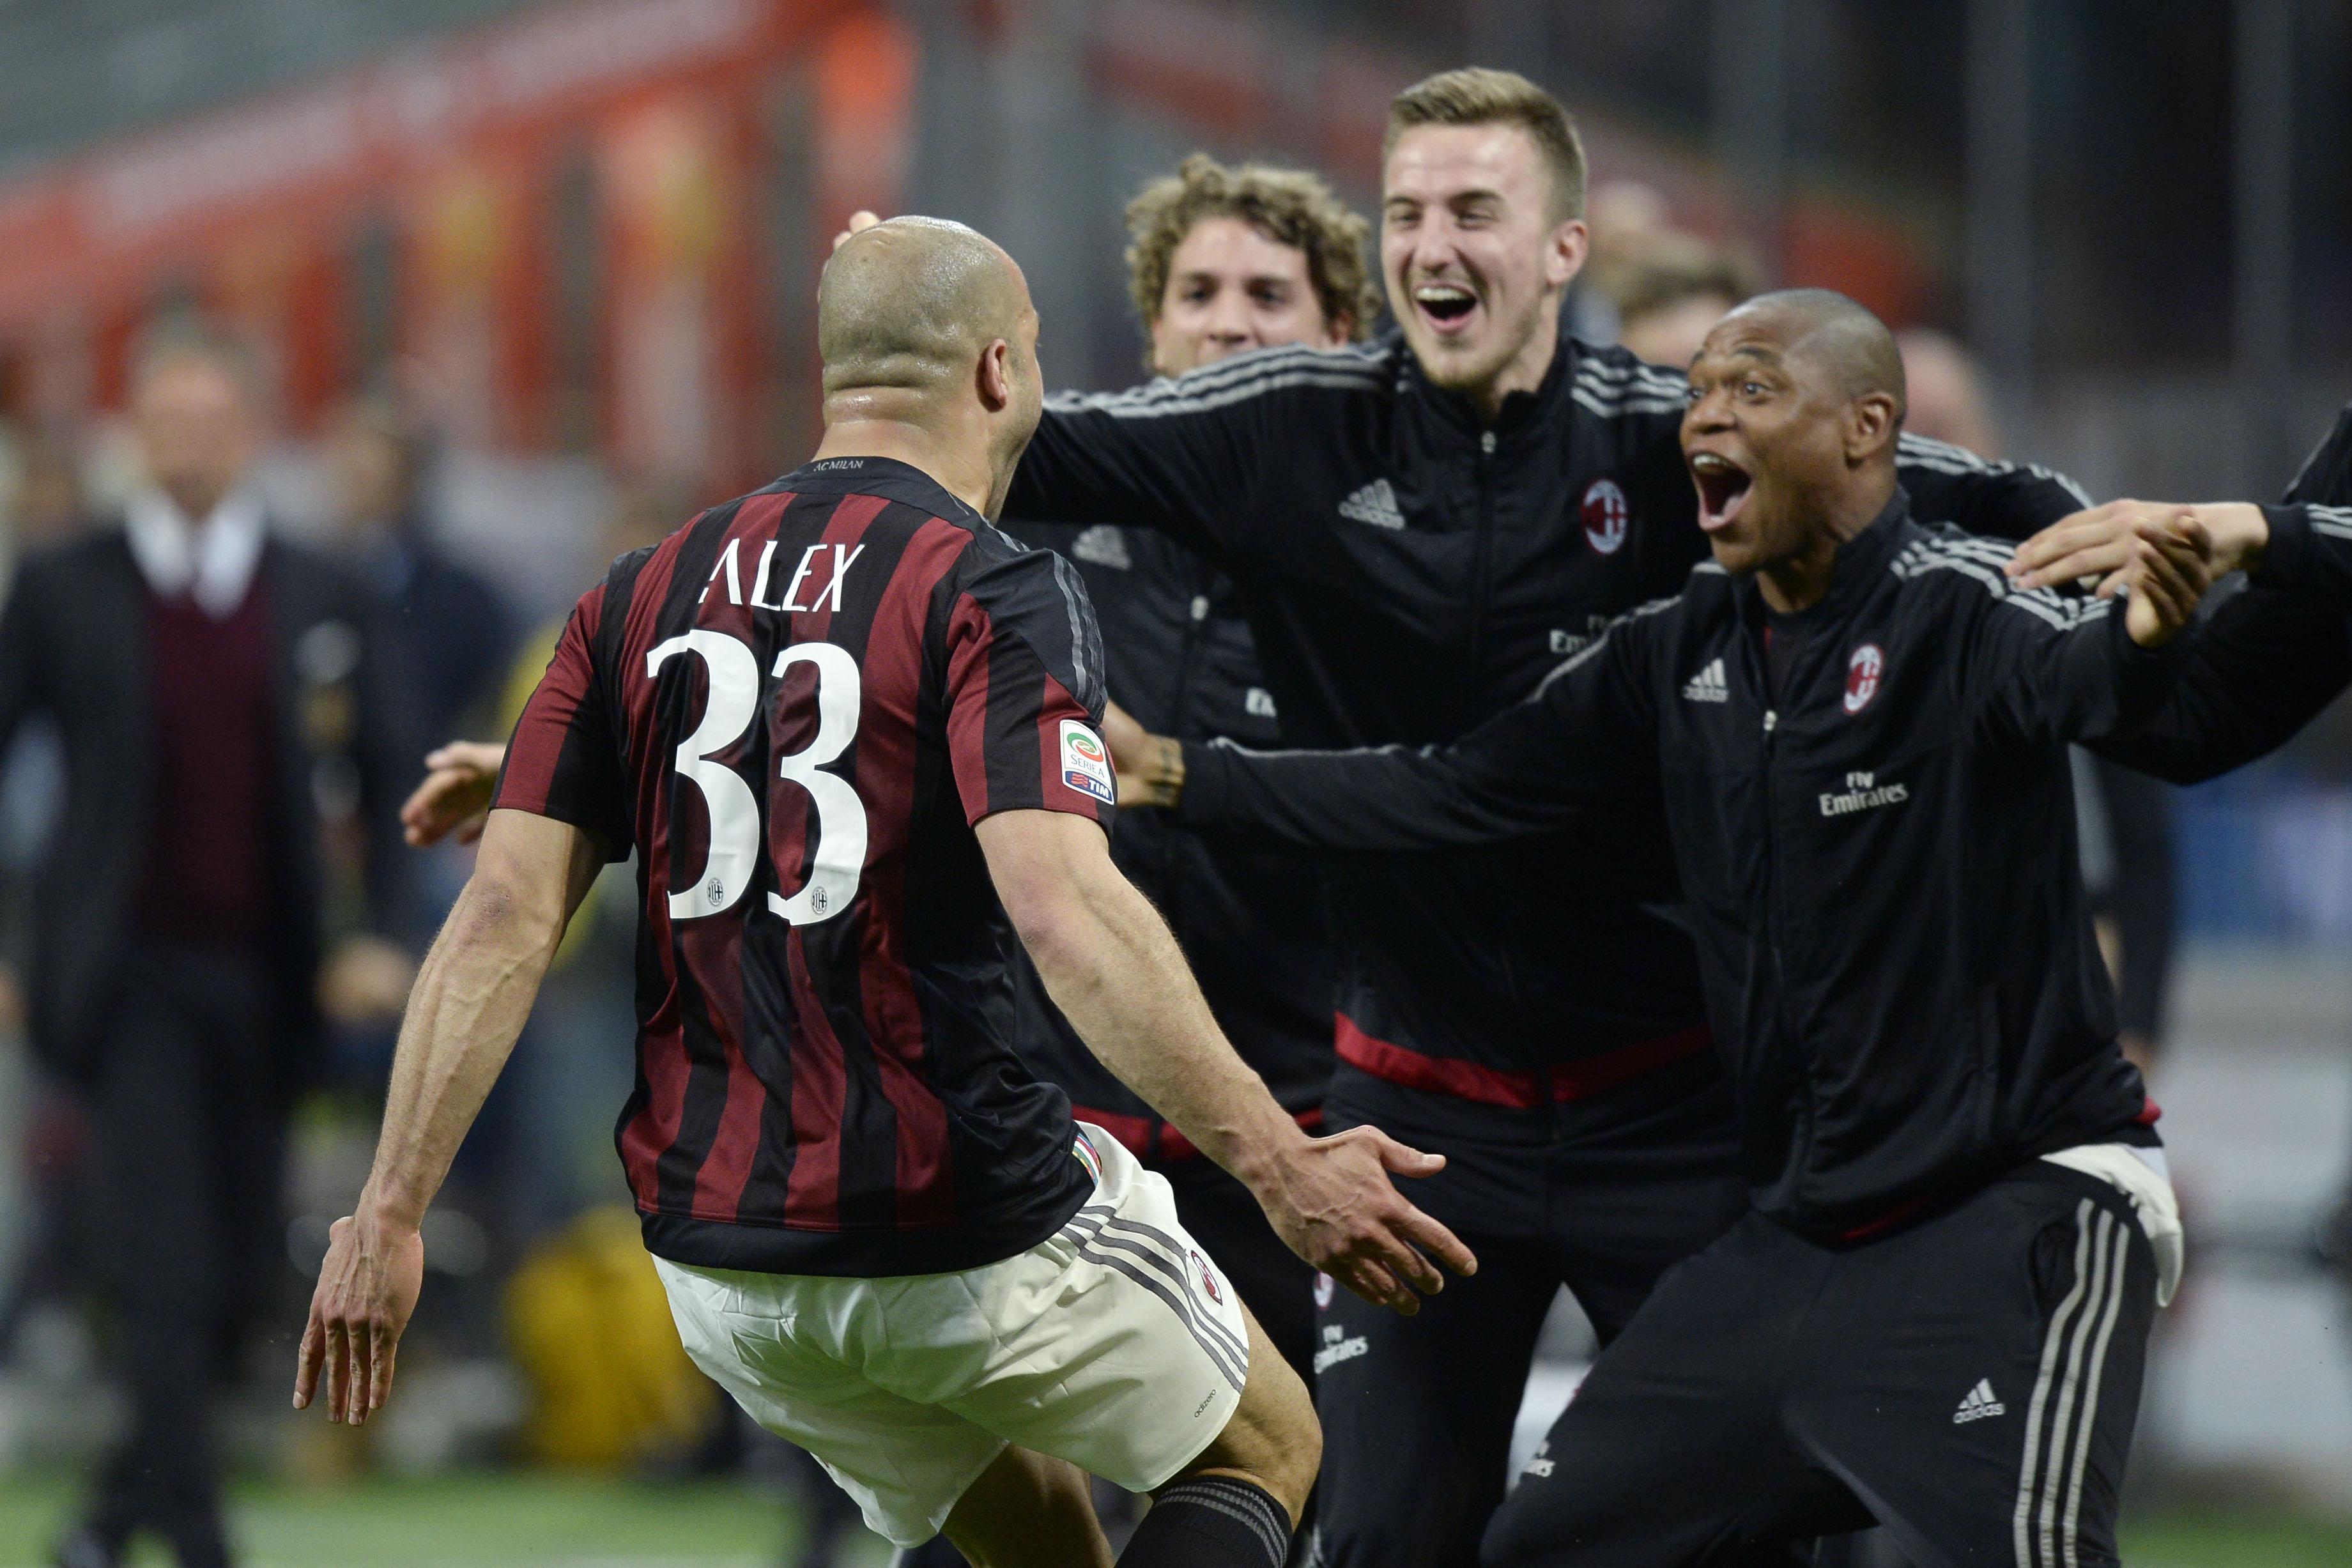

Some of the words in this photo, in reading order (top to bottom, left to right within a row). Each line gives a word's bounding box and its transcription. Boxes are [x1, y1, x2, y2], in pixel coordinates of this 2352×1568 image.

[813, 462, 829, 472] AC
[829, 460, 863, 470] MILAN
[698, 538, 865, 612] ALEX
[646, 629, 868, 926] 33
[1070, 754, 1097, 774] SERIE
[1098, 767, 1105, 778] A
[1088, 779, 1109, 799] TIM
[1819, 783, 1908, 817] Emirates
[1194, 1389, 1217, 1418] adizero
[1953, 1402, 2006, 1425] adidas
